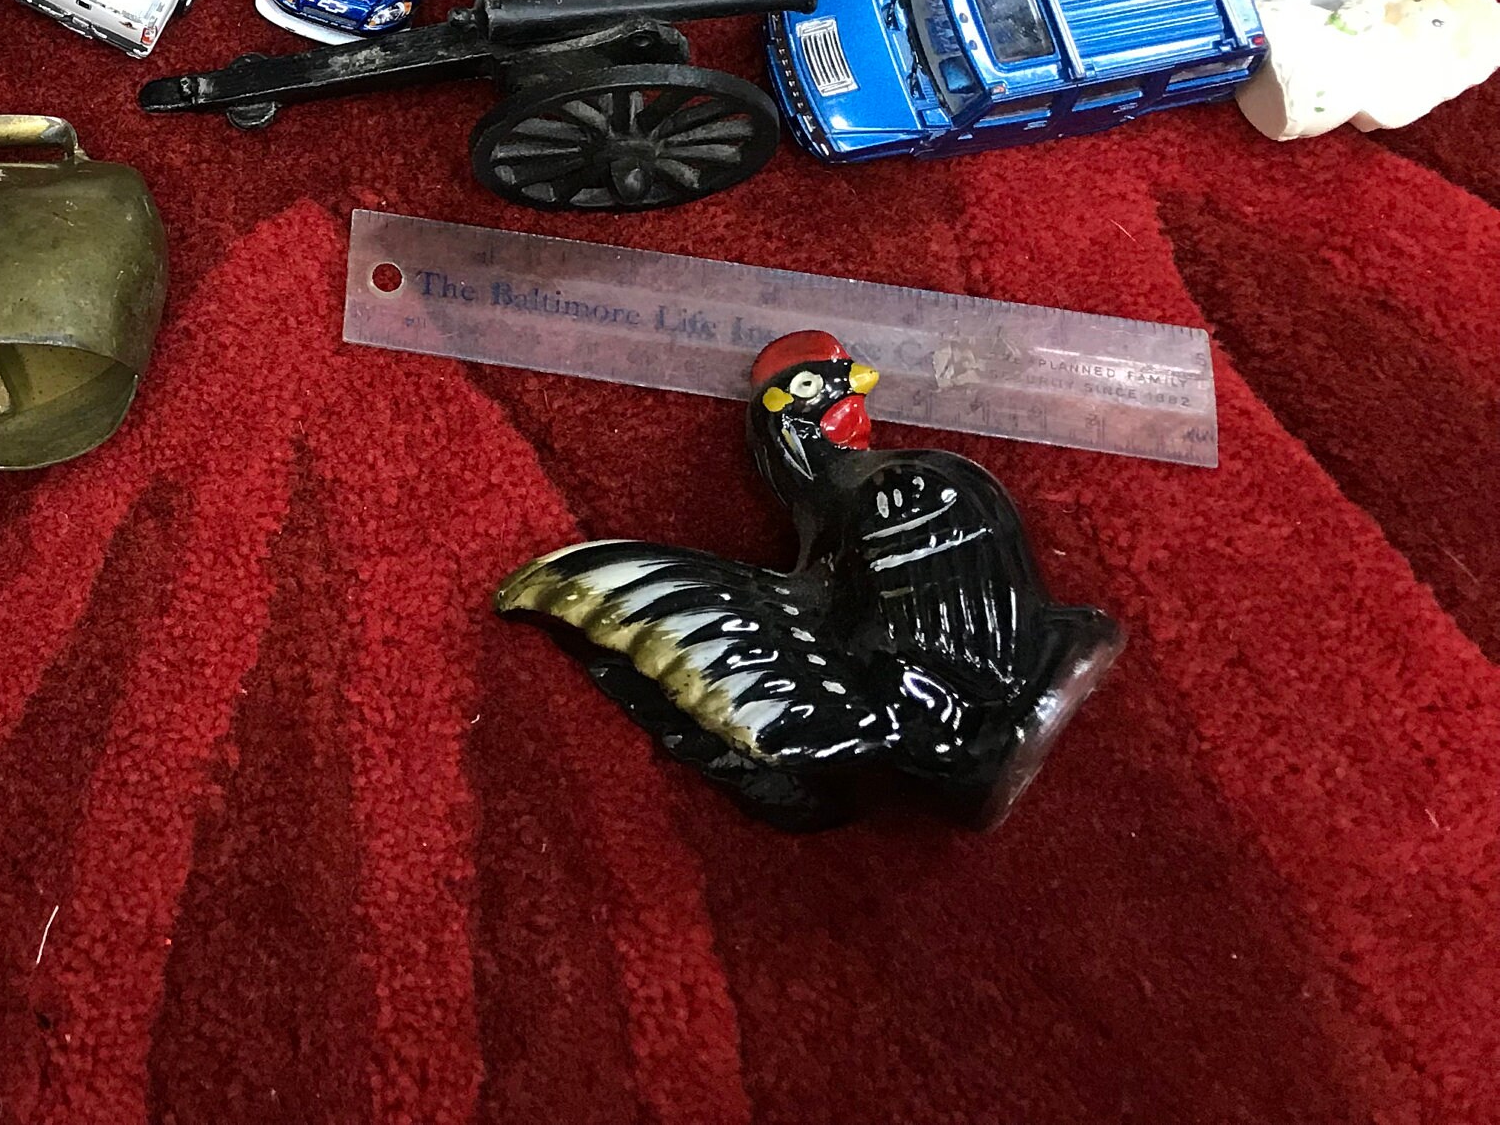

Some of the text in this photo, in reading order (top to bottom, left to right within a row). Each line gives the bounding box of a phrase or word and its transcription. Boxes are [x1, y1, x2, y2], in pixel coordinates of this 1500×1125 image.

[419, 270, 475, 302] The
[491, 282, 640, 326] Baltimore
[654, 305, 716, 338] Life
[1038, 358, 1189, 388] PLANNED FAMILY
[1083, 382, 1138, 401] SINCE
